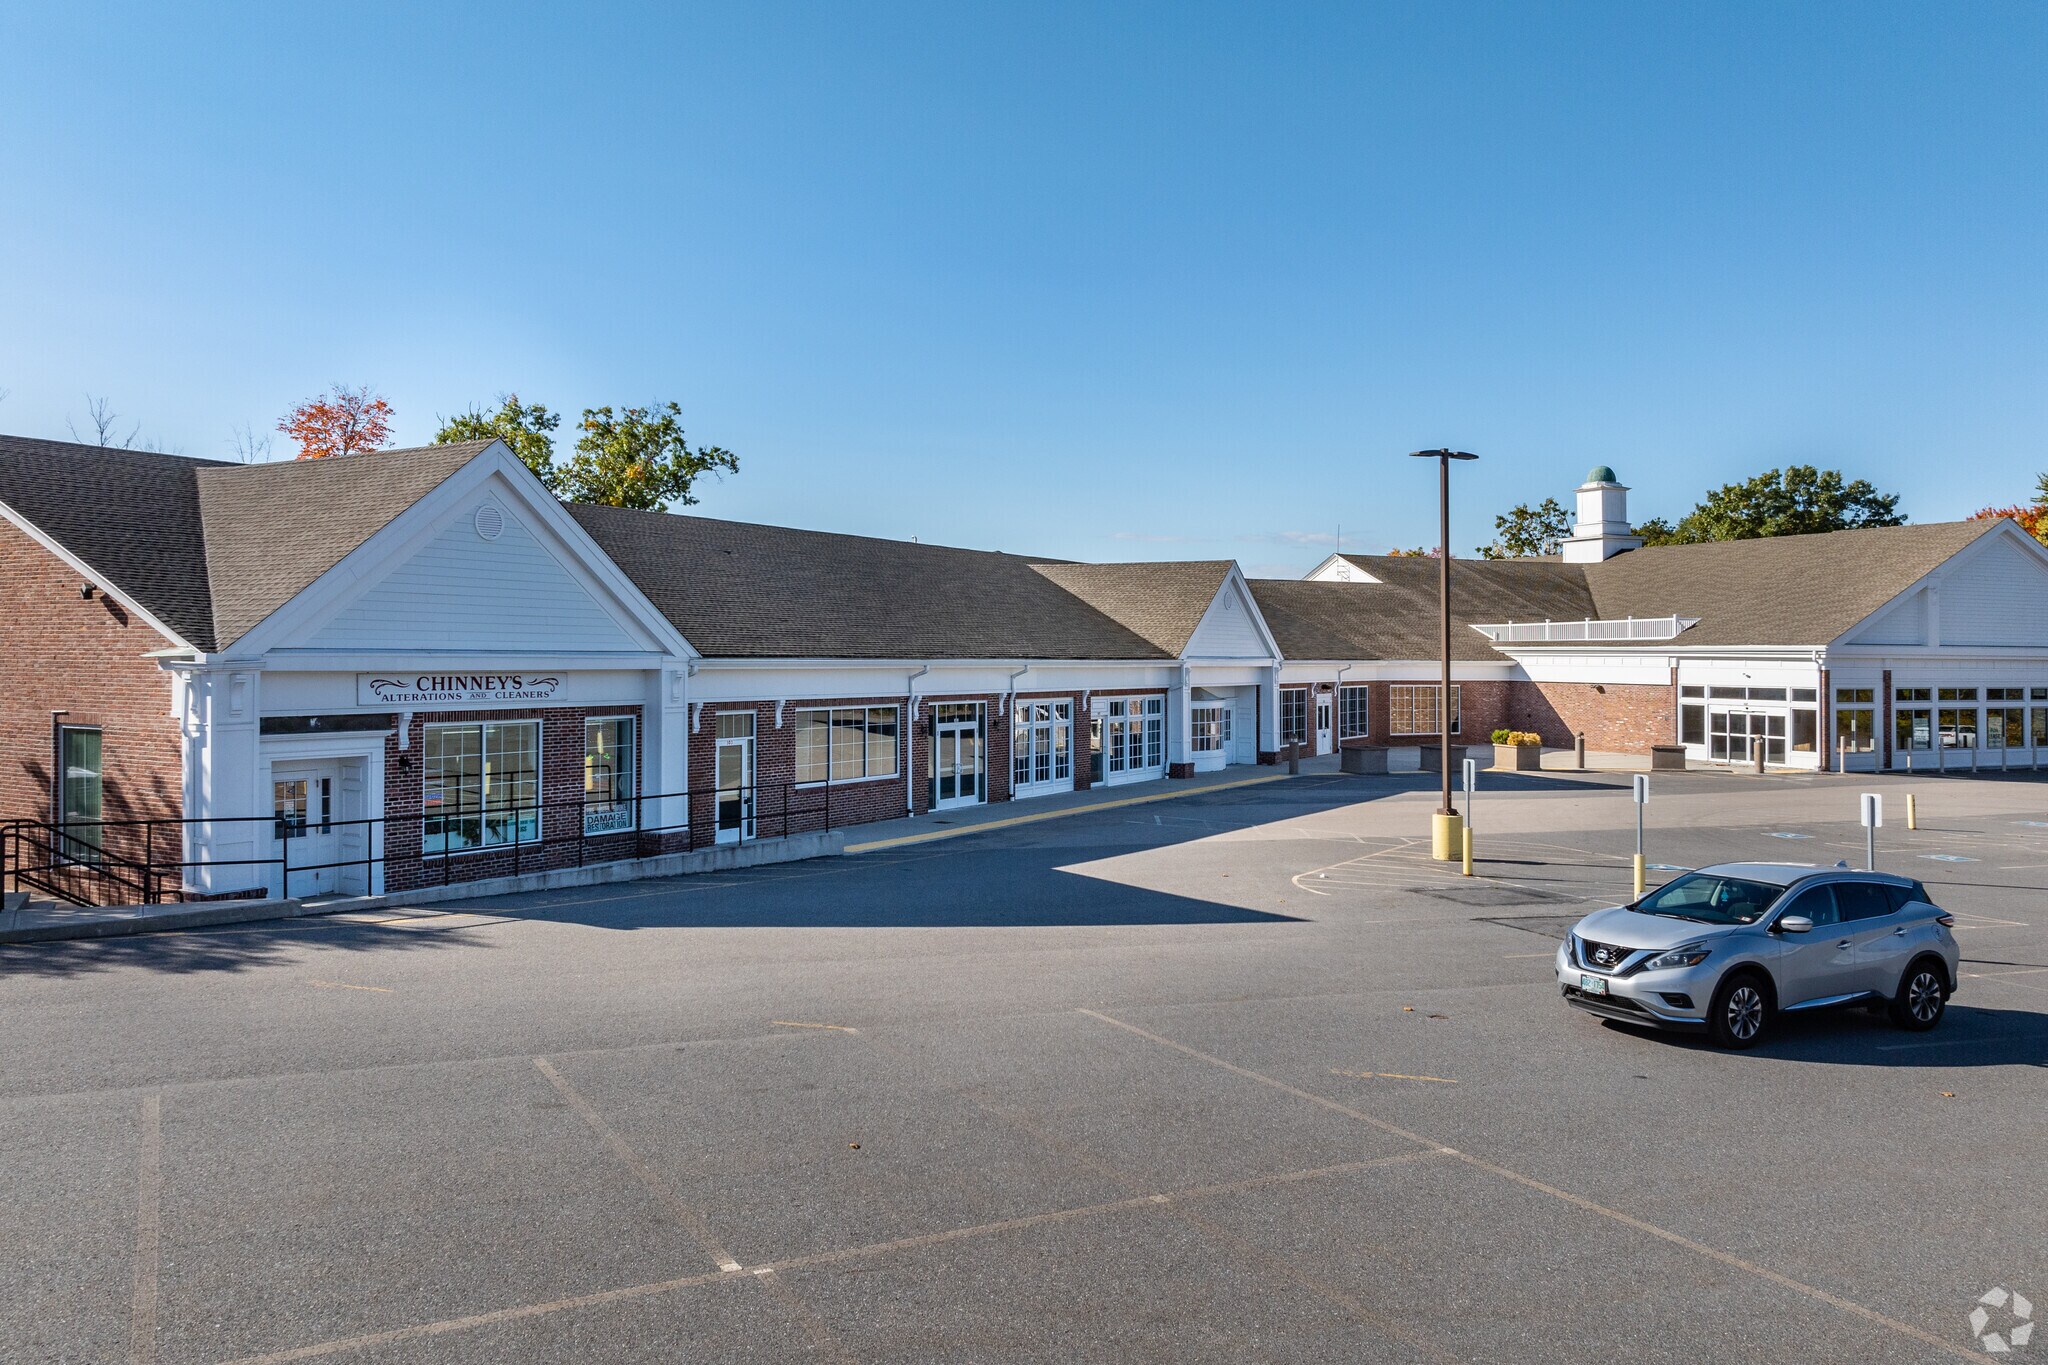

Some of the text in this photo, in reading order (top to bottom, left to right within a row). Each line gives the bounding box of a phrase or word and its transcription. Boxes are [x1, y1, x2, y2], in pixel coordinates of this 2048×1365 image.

[416, 675, 523, 691] CHINNEY'S
[381, 692, 463, 702] ALTERATIONS
[495, 691, 550, 699] CLEANERS
[587, 812, 627, 825] DAMAGE
